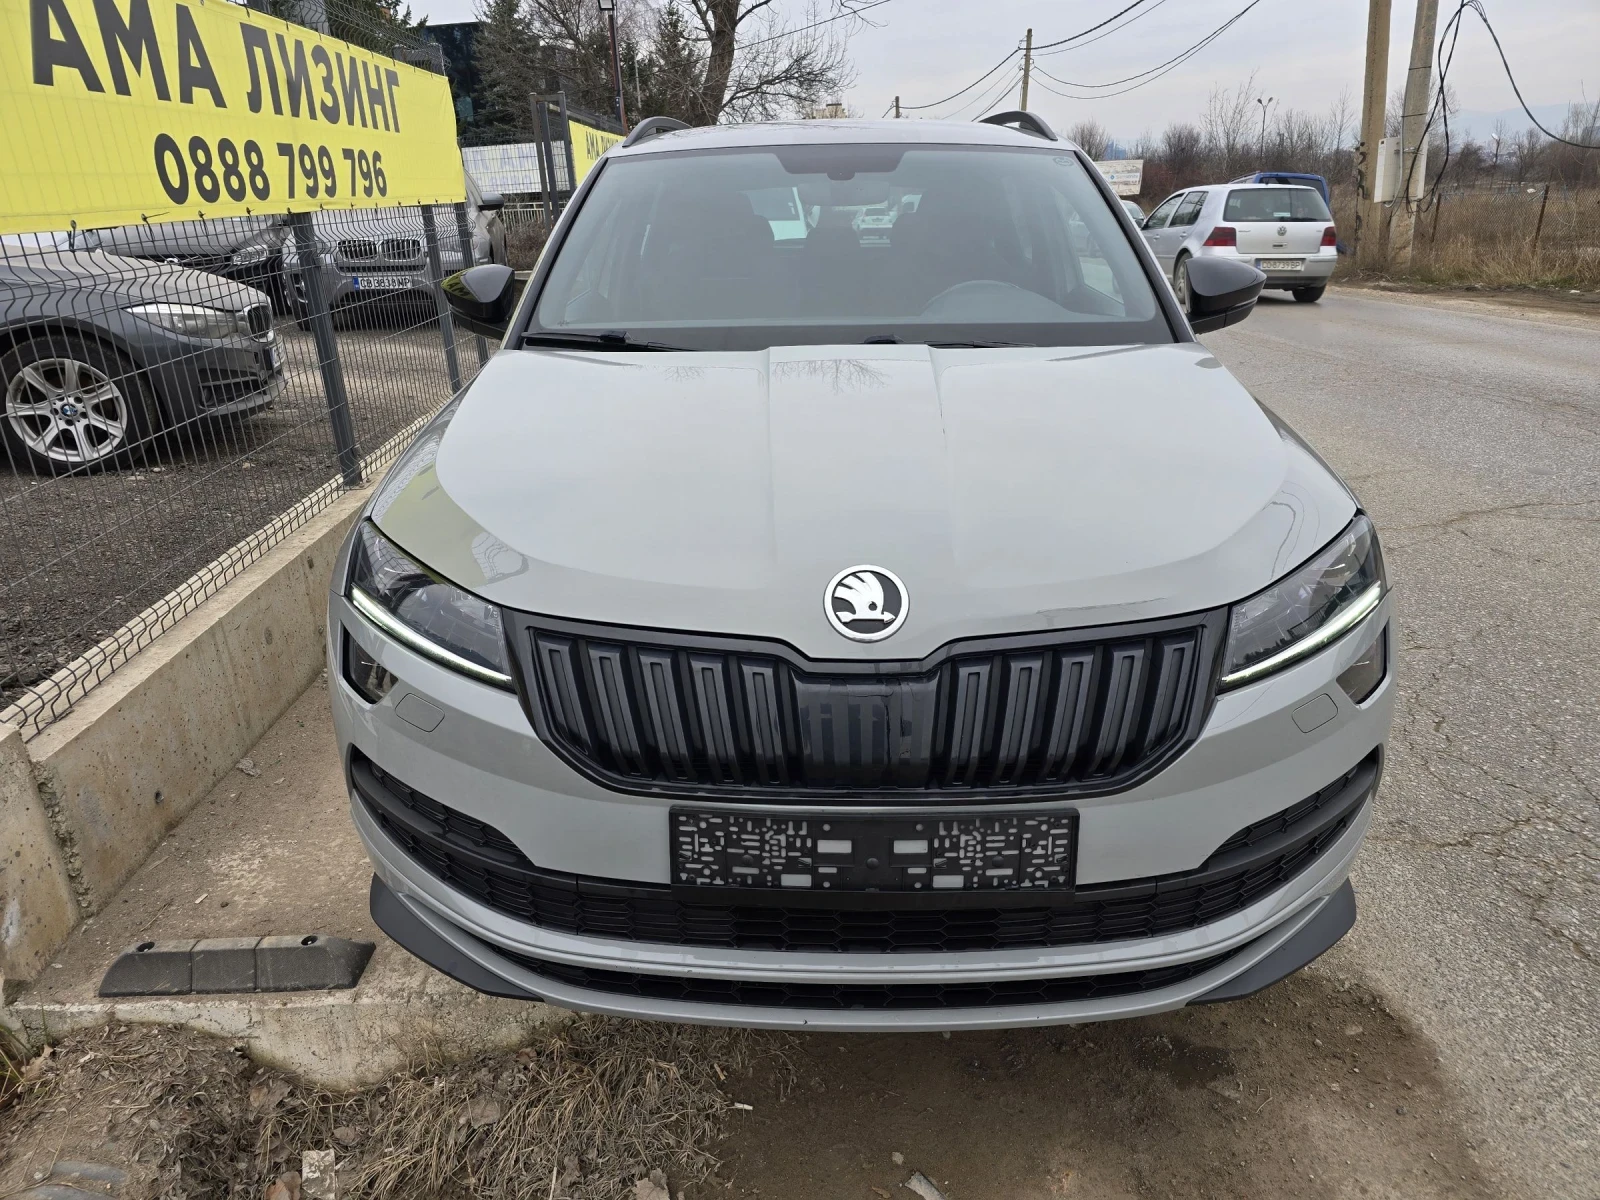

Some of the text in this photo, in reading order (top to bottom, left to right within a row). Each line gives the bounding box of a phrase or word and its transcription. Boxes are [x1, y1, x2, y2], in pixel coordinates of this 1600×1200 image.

[30, 0, 400, 133] АМА ЛИЗИНГ
[154, 133, 388, 205] 0888 799 796
